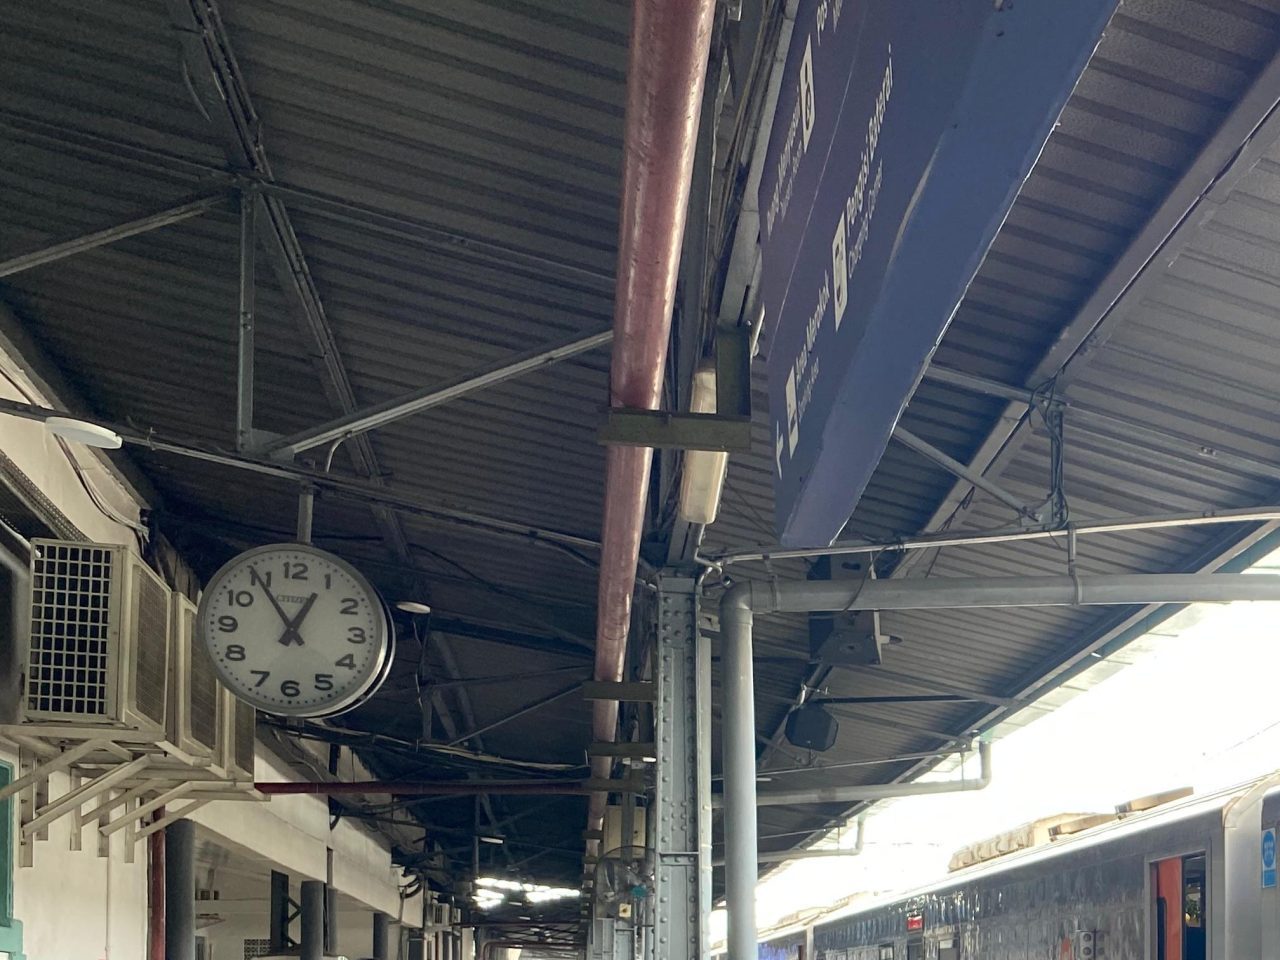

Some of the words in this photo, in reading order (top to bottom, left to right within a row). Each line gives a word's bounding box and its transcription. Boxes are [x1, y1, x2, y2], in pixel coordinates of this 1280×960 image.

[847, 134, 869, 237] Pengisi
[869, 43, 893, 162] Baterai
[283, 561, 309, 580] 12
[324, 574, 332, 590] 1
[227, 590, 254, 607] 10
[339, 598, 359, 615] 2
[218, 615, 238, 632] 9
[346, 627, 366, 644] 3
[225, 645, 246, 661] 8
[335, 654, 356, 670] 4
[250, 671, 270, 687] 7
[314, 674, 334, 690] 5
[280, 681, 300, 697] 6
